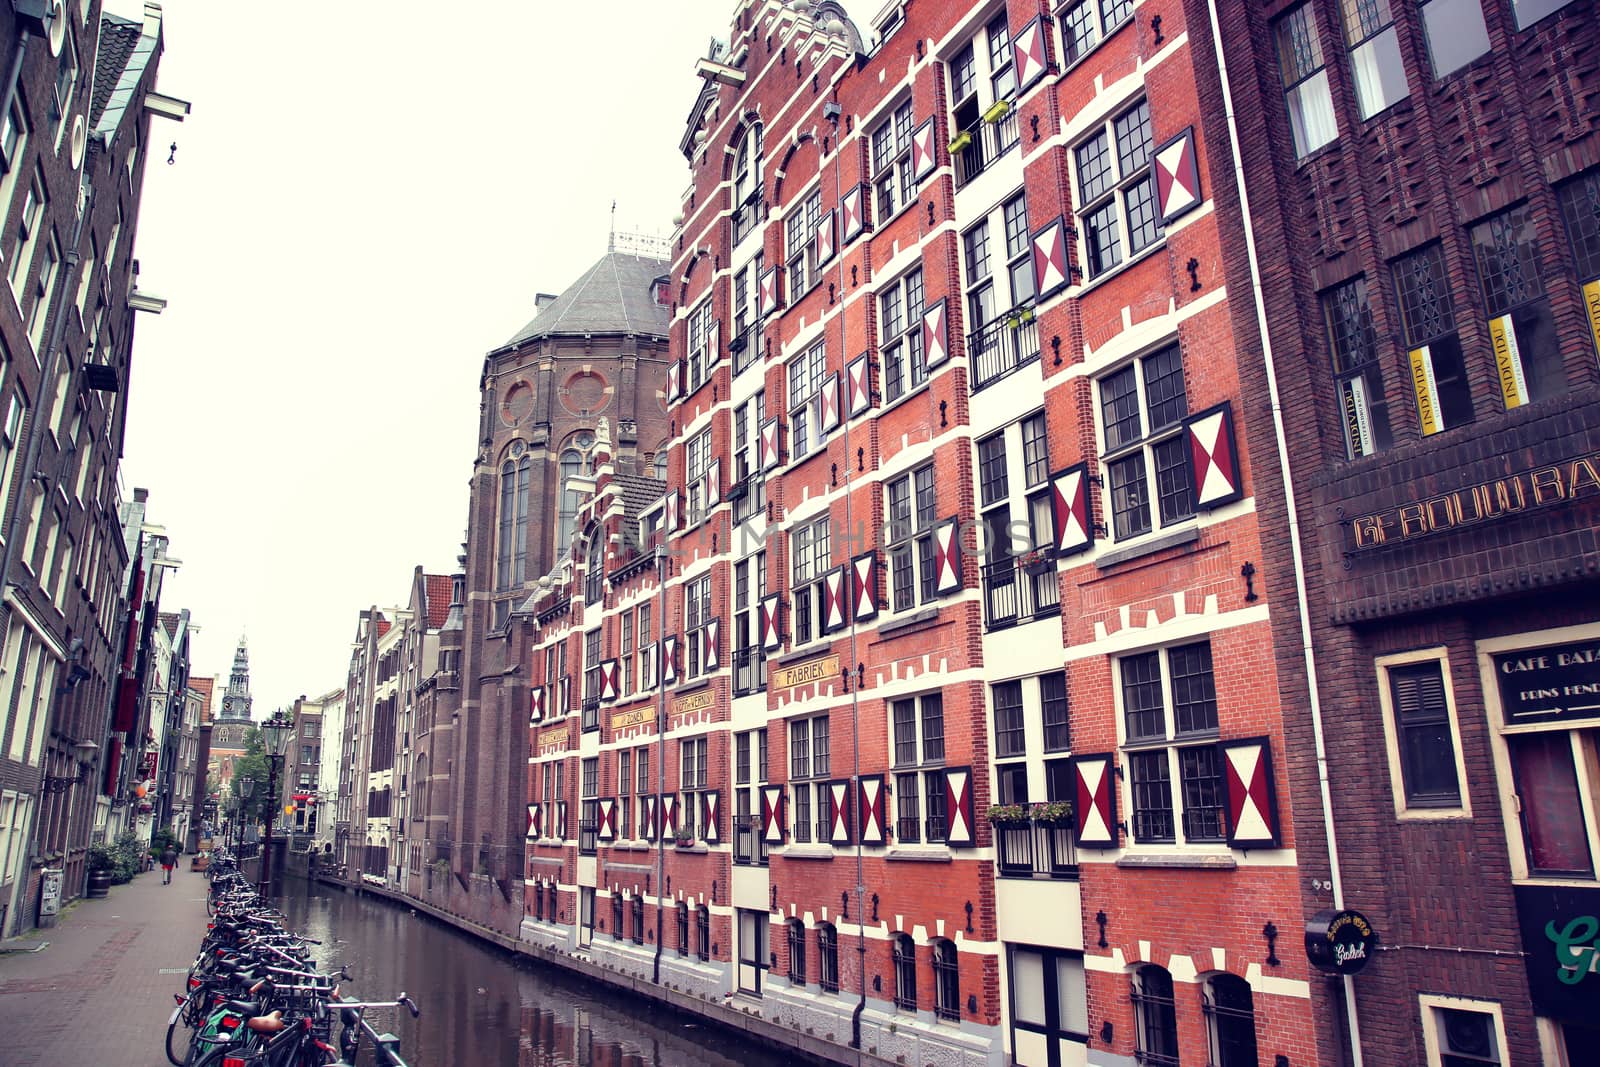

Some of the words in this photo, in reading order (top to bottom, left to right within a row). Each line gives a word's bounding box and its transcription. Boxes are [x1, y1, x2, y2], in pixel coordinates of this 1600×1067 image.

[1494, 328, 1516, 398] INDIVIDU
[1413, 359, 1433, 426] INDIVIDU
[1344, 390, 1362, 454] INDIVIDU
[1531, 456, 1600, 506] BA
[786, 661, 825, 685] FABRIEK
[1502, 656, 1551, 674] CAFE
[1520, 687, 1560, 701] PRINS
[1545, 915, 1600, 985] G
